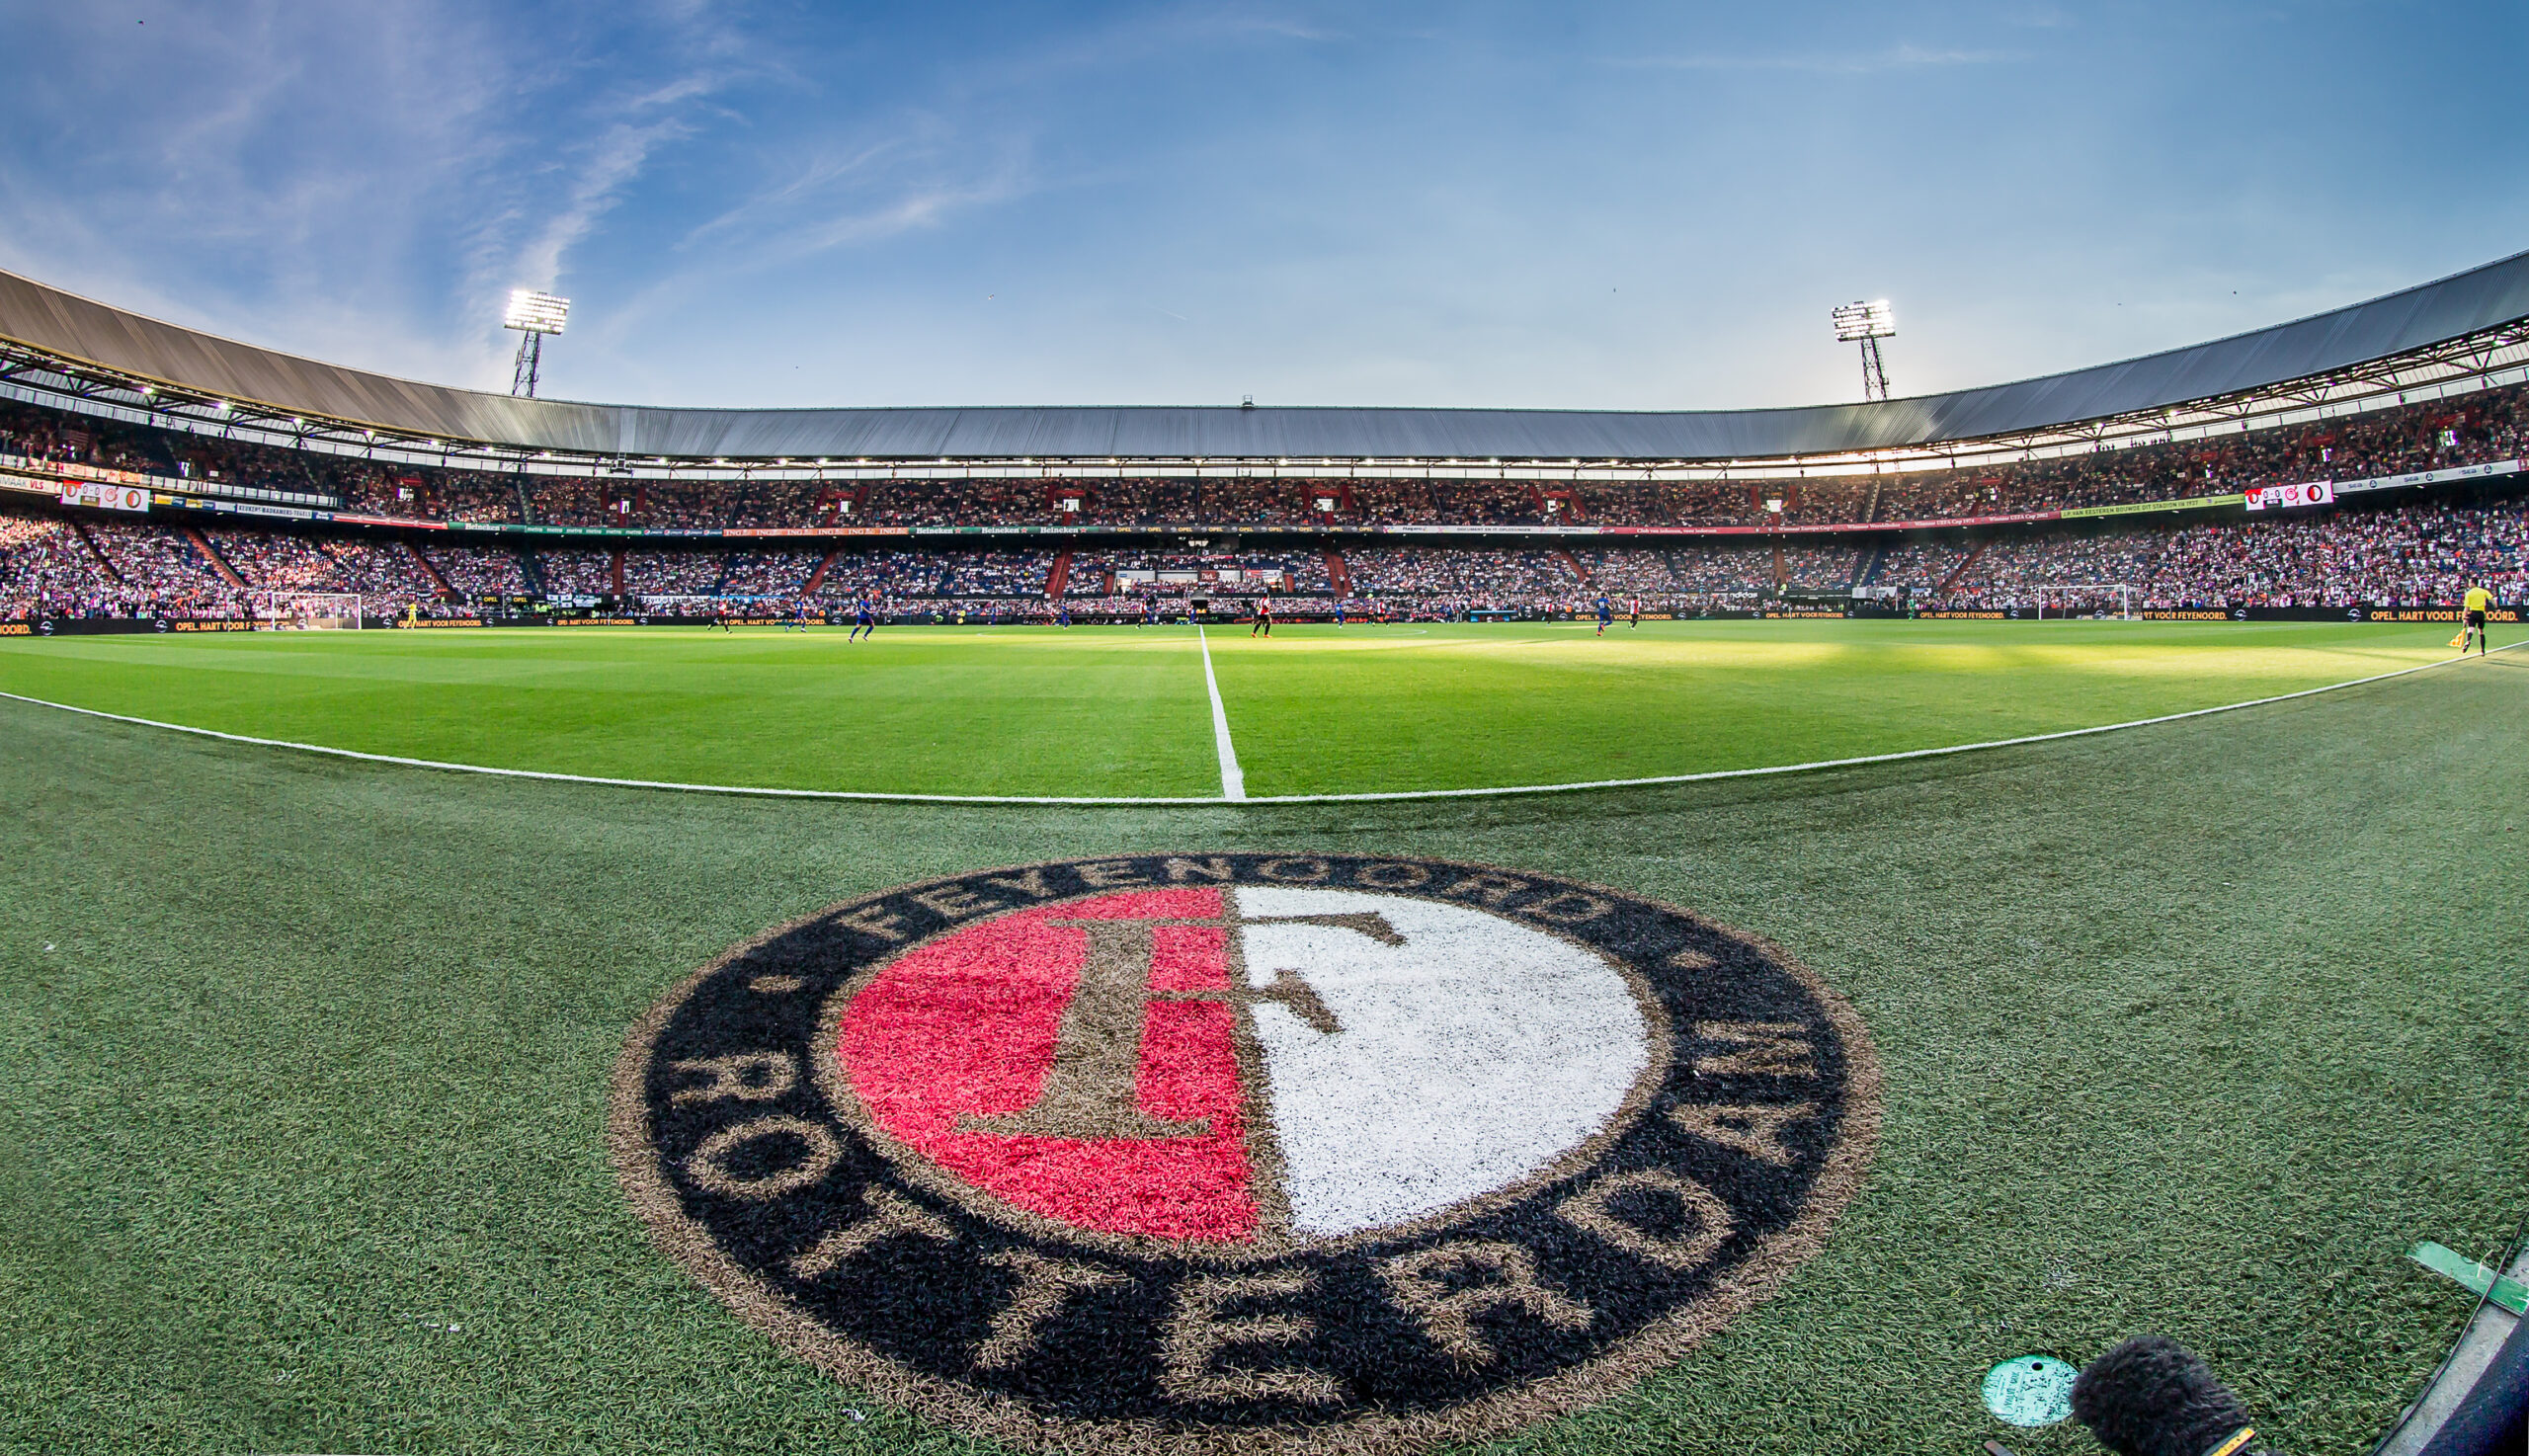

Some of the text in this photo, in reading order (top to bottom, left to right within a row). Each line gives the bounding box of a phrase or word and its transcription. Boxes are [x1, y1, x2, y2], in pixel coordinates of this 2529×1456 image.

[30, 479, 44, 490] VLS
[2155, 611, 2176, 620] VOOR
[2399, 611, 2424, 621] HART
[2426, 611, 2454, 621] VOOR
[200, 621, 220, 631] HART
[835, 853, 1614, 945] FEYENOORD
[666, 1020, 1818, 1405] ROTTERDAM
